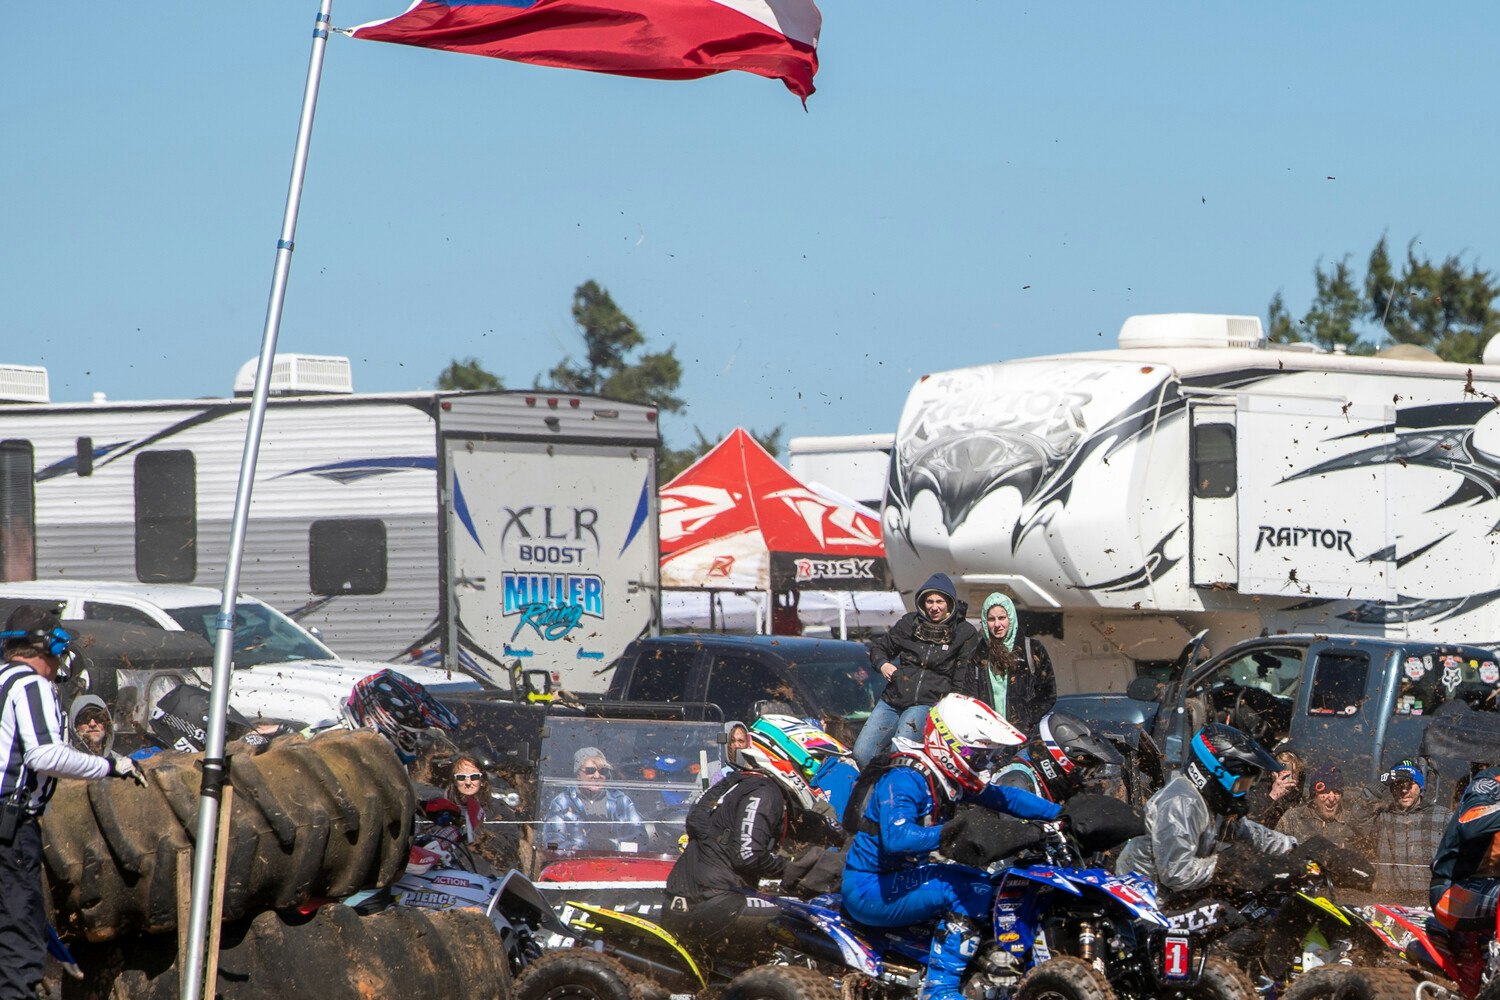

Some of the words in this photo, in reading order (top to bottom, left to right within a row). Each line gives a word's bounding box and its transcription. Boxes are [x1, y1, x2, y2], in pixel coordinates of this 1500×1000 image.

[502, 506, 599, 552] XLR
[1254, 525, 1356, 558] RAPTOR
[519, 544, 585, 564] BOOST
[812, 559, 876, 579] RISK
[503, 571, 604, 618] MILLER
[787, 772, 807, 791] 733
[740, 797, 761, 861] RACING
[434, 877, 467, 887] ACTION
[402, 892, 457, 906] PIERCE
[1167, 903, 1220, 931] FLY
[1170, 944, 1182, 973] 1
